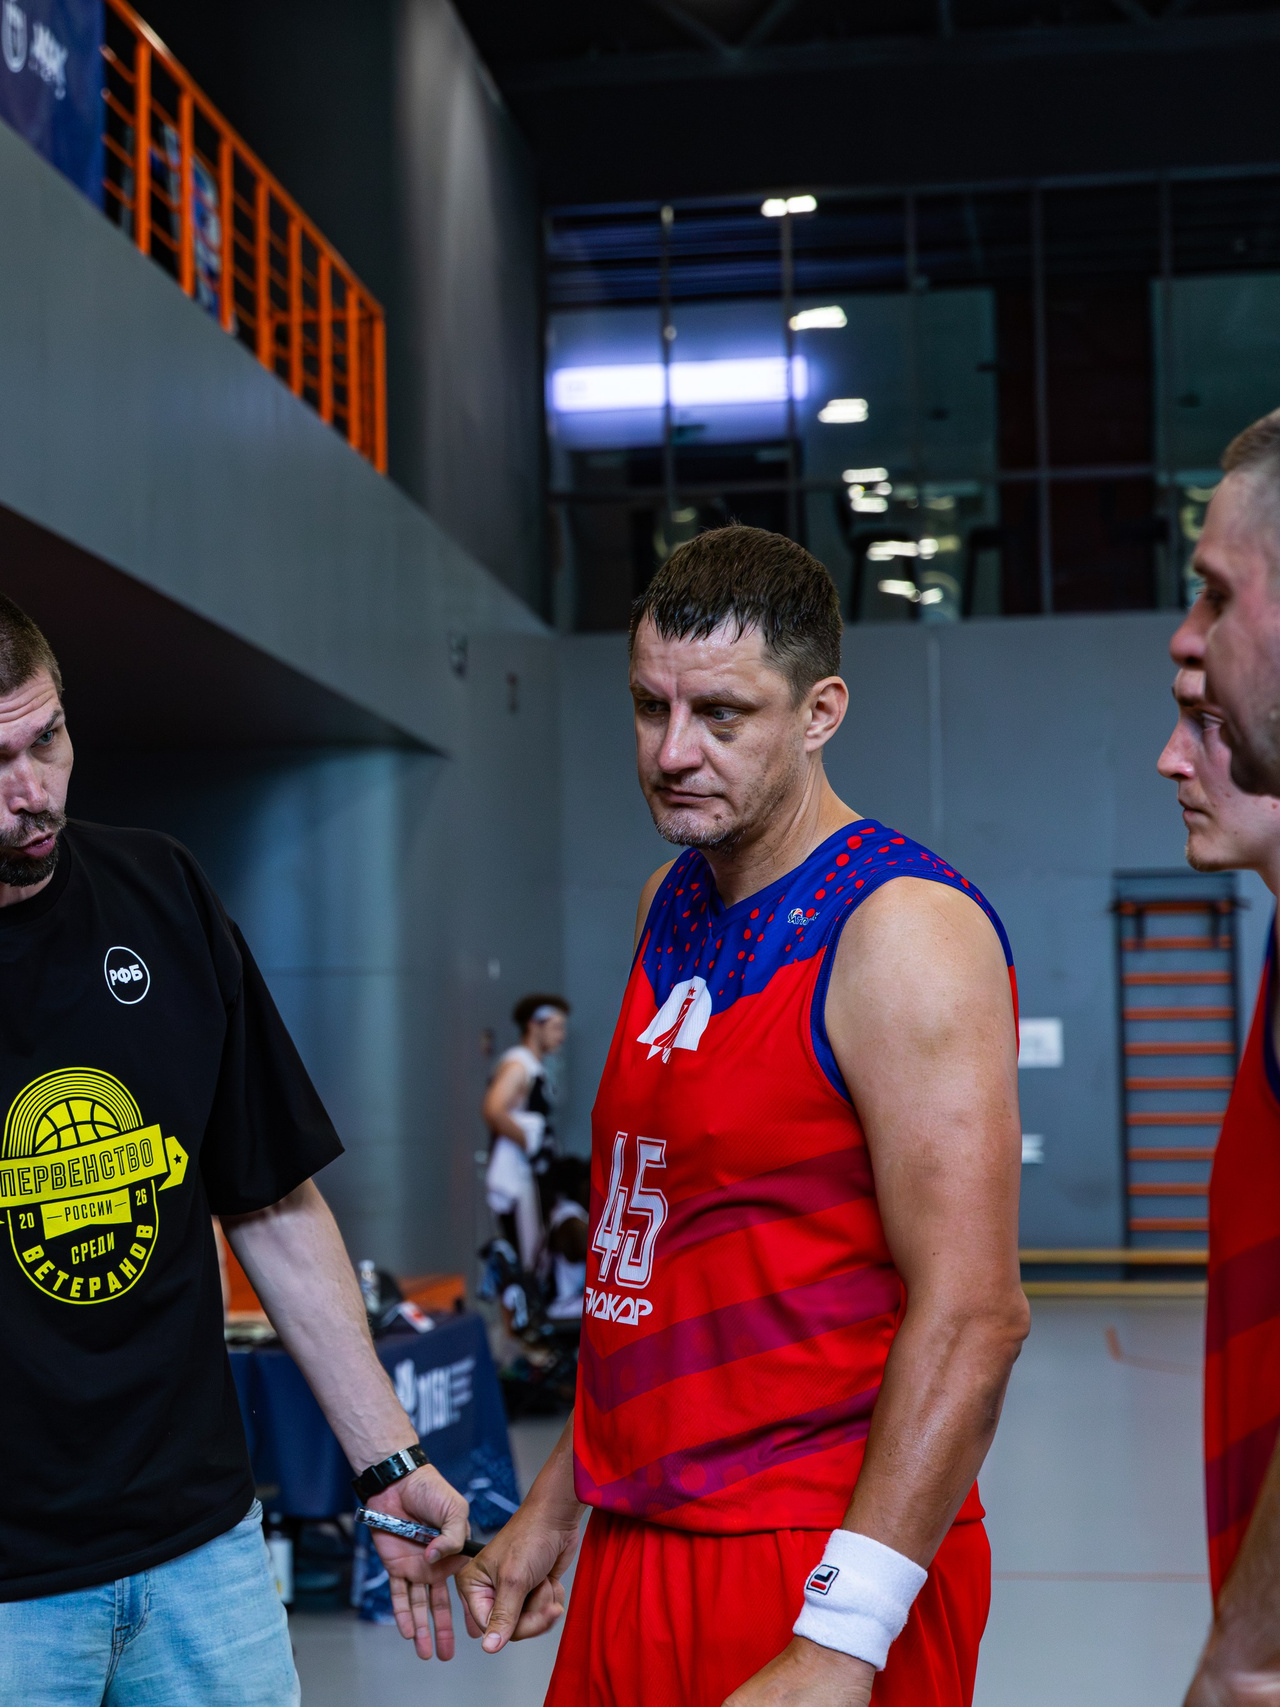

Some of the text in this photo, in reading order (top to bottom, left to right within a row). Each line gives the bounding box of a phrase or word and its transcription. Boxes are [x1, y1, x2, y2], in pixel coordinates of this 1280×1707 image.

[108, 963, 144, 987] РФБ
[135, 1188, 149, 1207] 26
[18, 1212, 36, 1230] 20
[63, 1199, 114, 1223] РОССИИ
[592, 1131, 668, 1289] 45
[70, 1231, 115, 1265] СРЕДИ
[22, 1223, 154, 1299] ВЕТЕРАНОВ
